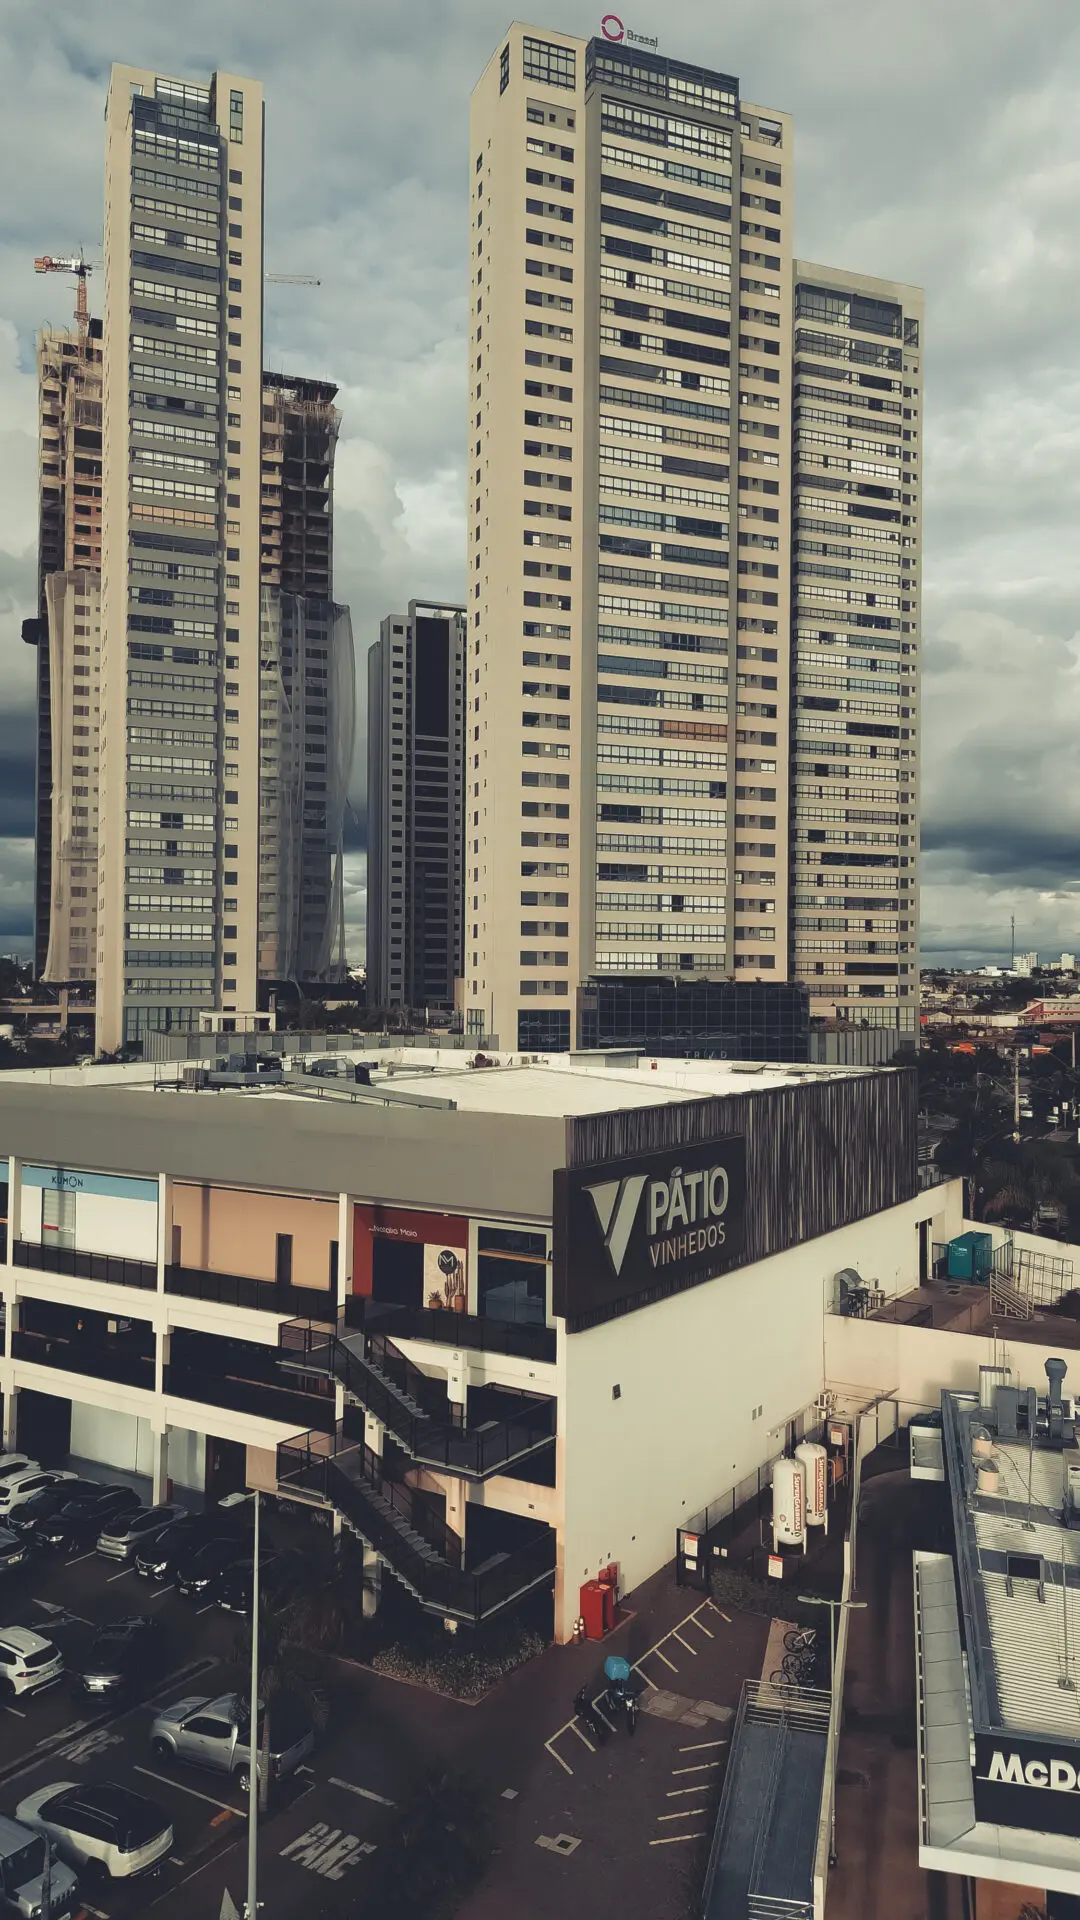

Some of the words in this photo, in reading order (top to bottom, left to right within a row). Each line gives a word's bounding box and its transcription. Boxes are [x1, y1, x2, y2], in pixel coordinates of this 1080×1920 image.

[627, 30, 658, 48] Brasal
[52, 1175, 84, 1188] KUMON
[647, 1165, 729, 1235] PÁTIO
[650, 1221, 726, 1268] VINHEDOS
[988, 1751, 1080, 1791] McD
[279, 1822, 378, 1880] PARE
